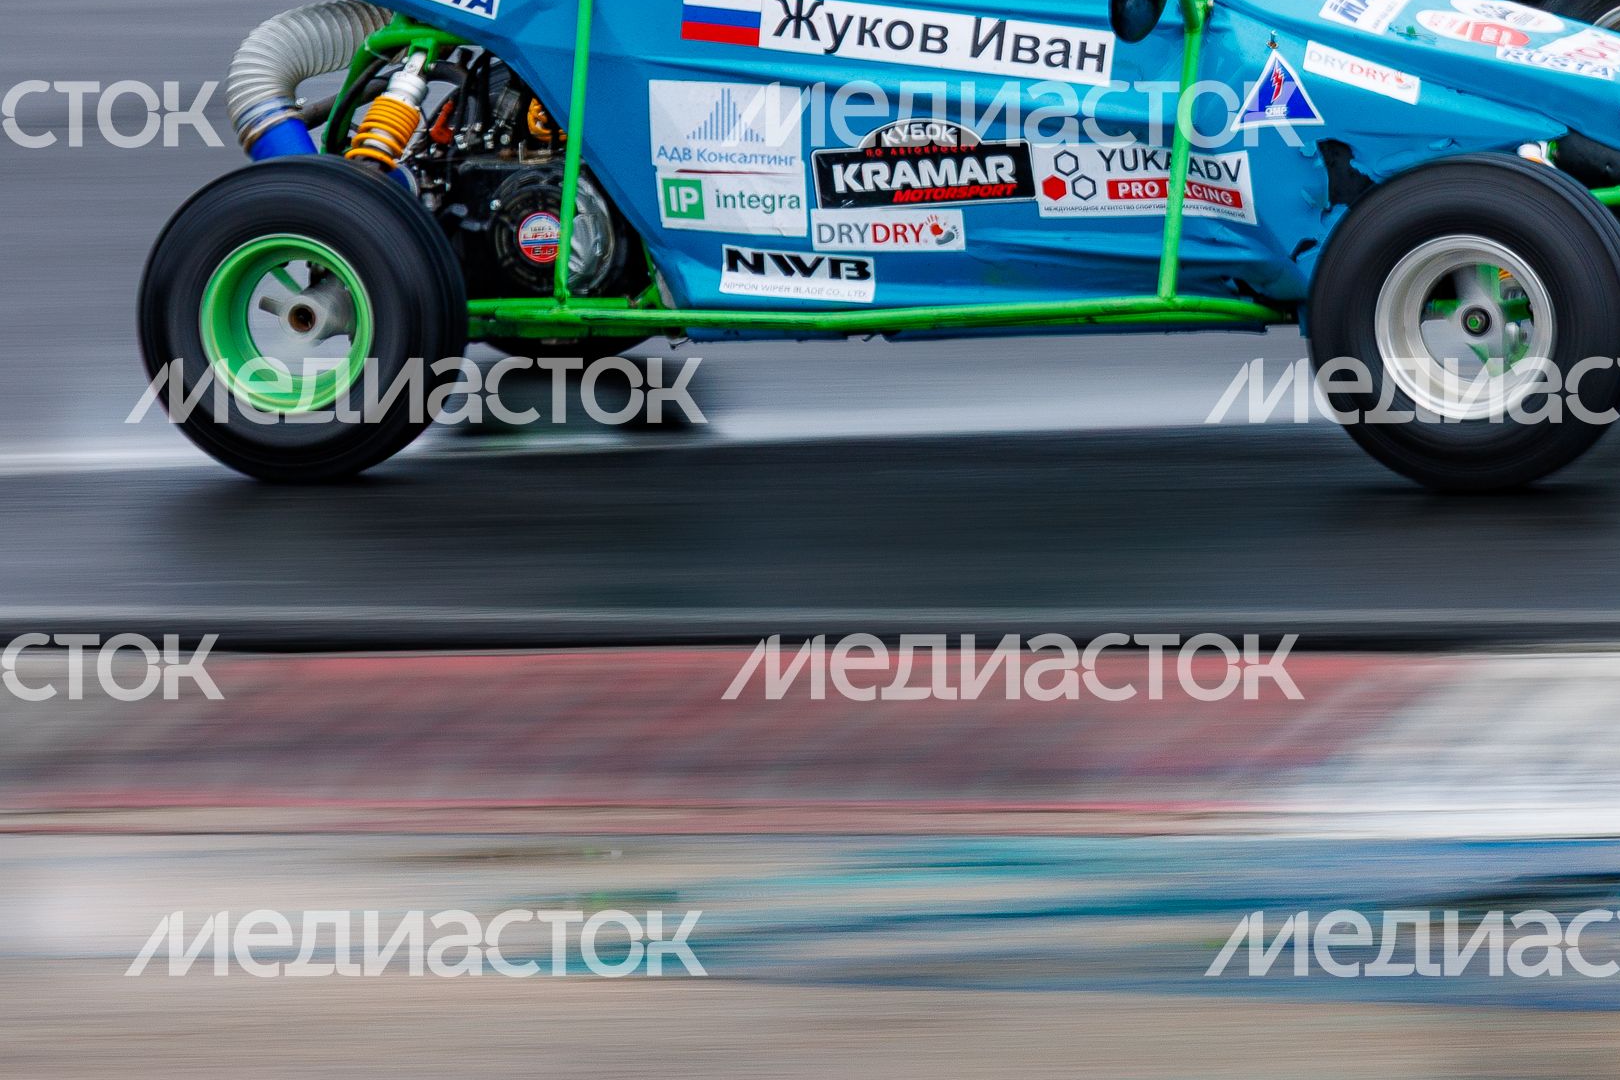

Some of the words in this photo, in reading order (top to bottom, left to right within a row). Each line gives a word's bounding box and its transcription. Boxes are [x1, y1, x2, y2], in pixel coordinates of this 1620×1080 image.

[970, 16, 1107, 73] Иван
[1309, 50, 1391, 83] DRYDRY
[881, 123, 957, 146] КУБОК
[657, 146, 691, 162] АДВ
[696, 149, 796, 167] Консалтинг
[832, 155, 1018, 193] KRAMAR
[1188, 159, 1241, 182] ADV
[669, 186, 699, 213] IP
[715, 189, 800, 214] integra
[893, 183, 1018, 203] MOTORSPORT
[1117, 182, 1160, 199] PRO
[1166, 182, 1233, 204] ACING
[816, 222, 924, 244] DRYDRY
[726, 248, 871, 280] NWB
